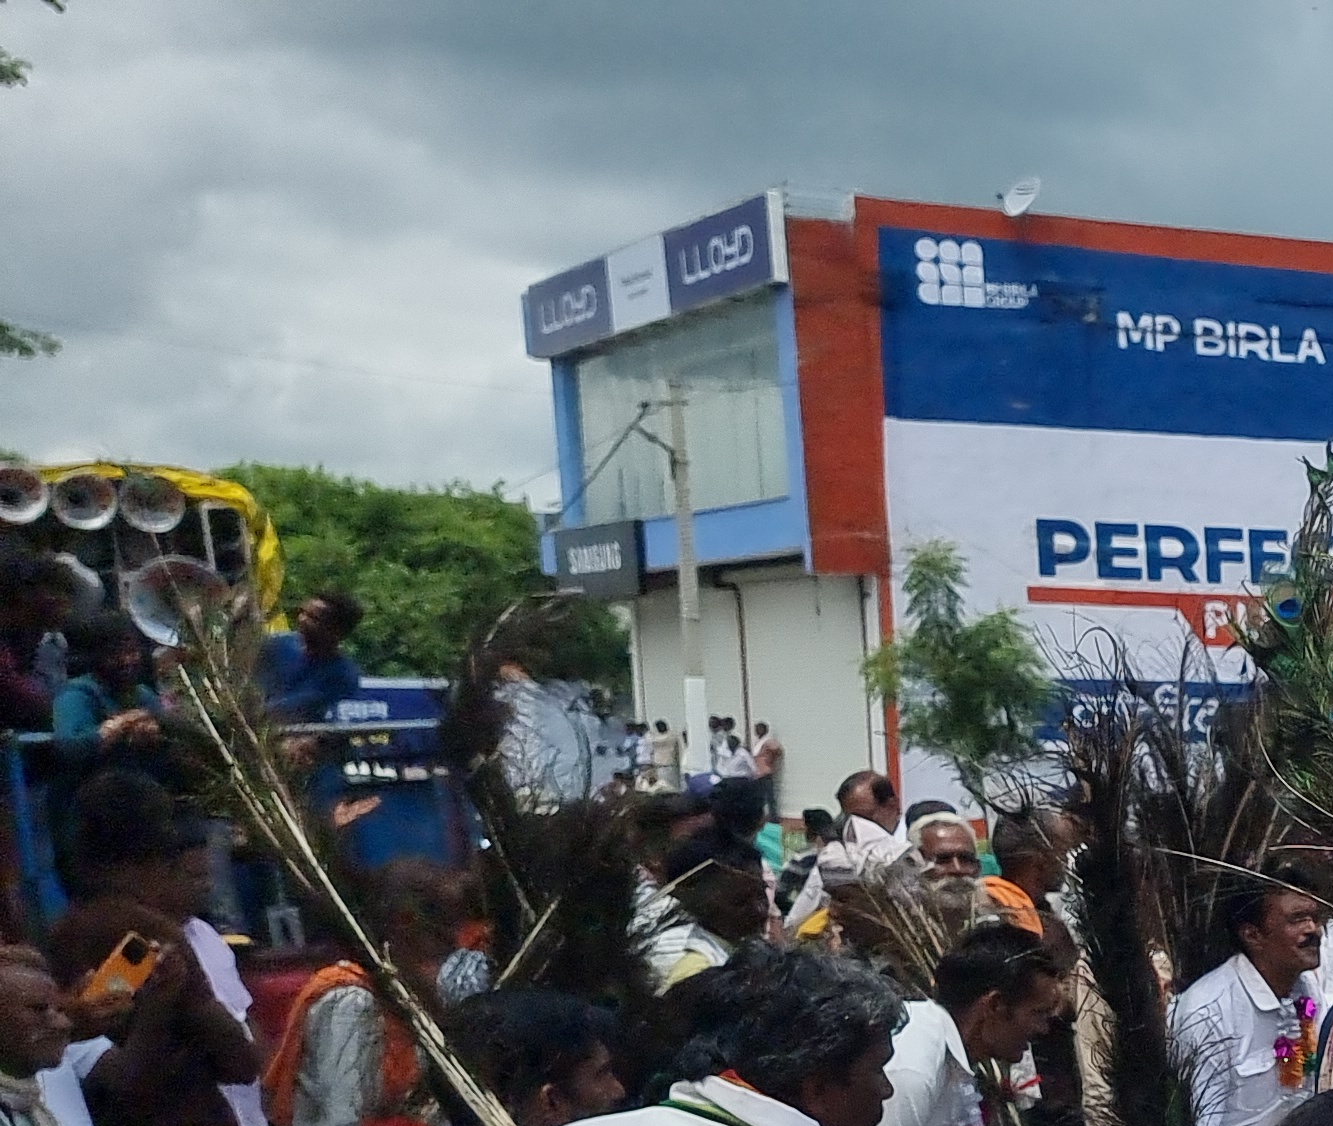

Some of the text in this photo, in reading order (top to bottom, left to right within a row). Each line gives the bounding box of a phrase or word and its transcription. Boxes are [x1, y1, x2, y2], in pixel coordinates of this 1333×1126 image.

[679, 225, 754, 285] LLOYD
[541, 284, 598, 334] LLOYD
[1116, 311, 1181, 352] MP
[1194, 318, 1326, 365] BIRLA
